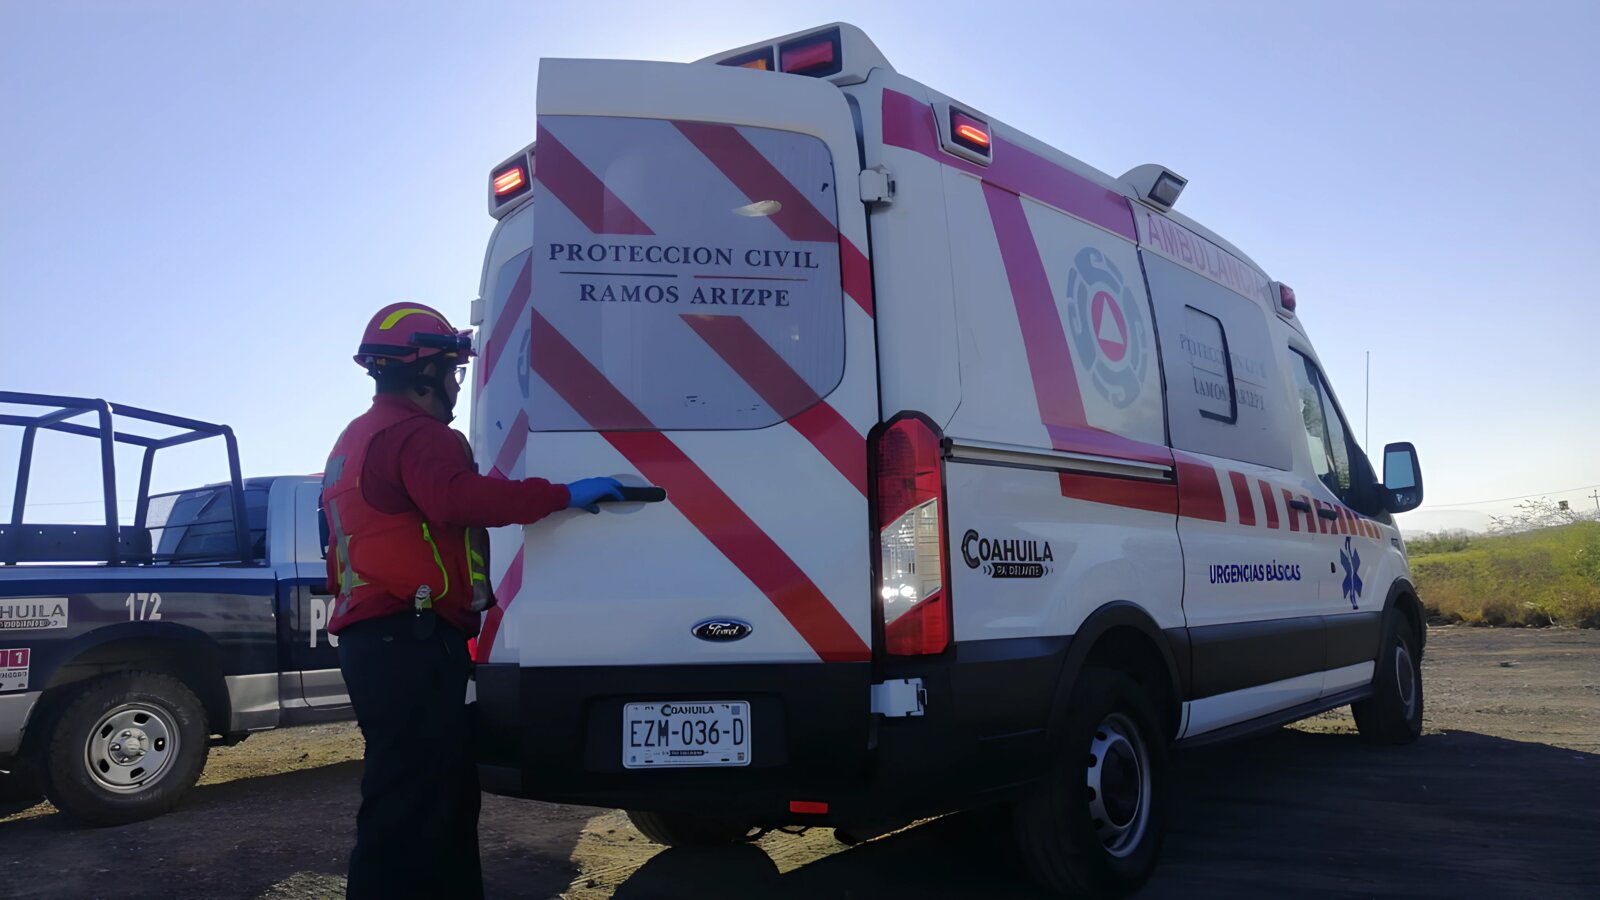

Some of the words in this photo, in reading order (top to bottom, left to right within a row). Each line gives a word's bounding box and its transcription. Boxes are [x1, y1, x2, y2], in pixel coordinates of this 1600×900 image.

[549, 243, 733, 266] PROTECCION
[744, 249, 819, 269] CIVIL
[1146, 213, 1266, 299] AMBULANCIA
[579, 284, 679, 304] RAMOS
[690, 287, 790, 307] ARIZPE
[961, 528, 1054, 570] COAHUILA
[1209, 564, 1264, 584] URGENCIAS
[125, 592, 162, 621] 172
[660, 704, 715, 717] COAHUILA
[630, 718, 744, 748] EZM-036-D
